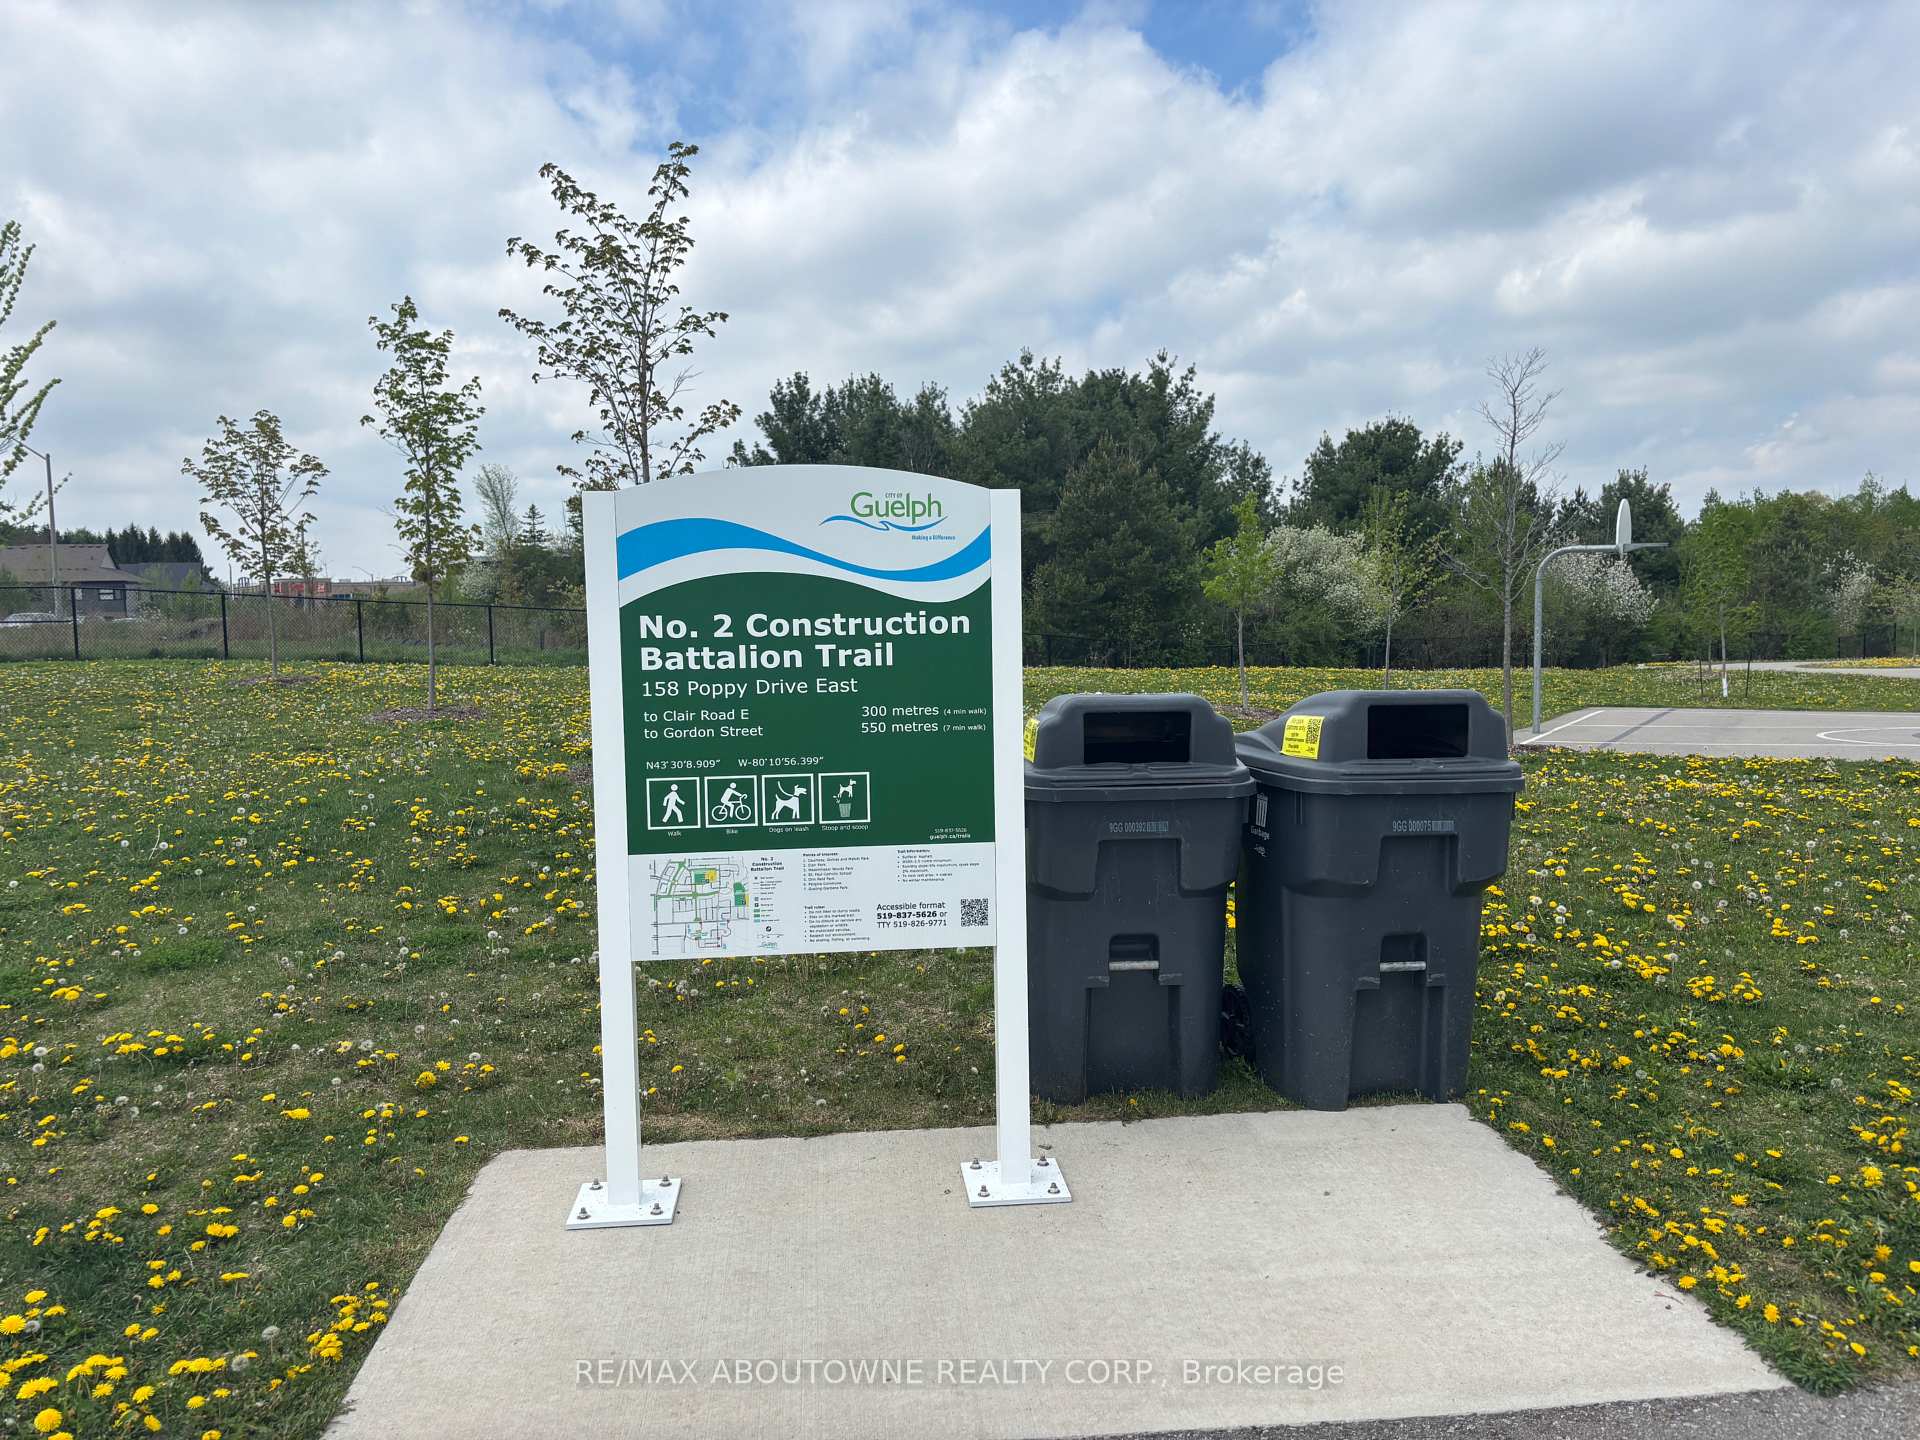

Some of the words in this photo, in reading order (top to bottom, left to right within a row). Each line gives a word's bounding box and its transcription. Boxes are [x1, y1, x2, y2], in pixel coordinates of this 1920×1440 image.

[850, 491, 942, 525] Guelph
[640, 615, 698, 639] No.
[714, 614, 734, 638] 2
[746, 610, 970, 638] Construction
[641, 645, 803, 671] Battalion
[816, 642, 894, 669] Trail
[642, 680, 679, 698] 158
[688, 680, 748, 698] Poppy
[756, 678, 808, 695] Drive
[816, 678, 858, 694] East
[644, 711, 659, 723] to
[663, 710, 696, 722] Clair
[700, 708, 736, 721] Road
[741, 709, 750, 720] E
[862, 705, 887, 718] 300
[892, 704, 940, 716] metres
[968, 707, 987, 716] walk)
[644, 728, 659, 739] to
[664, 726, 715, 738] Gordon
[720, 725, 764, 738] Street
[861, 722, 886, 734] 550
[892, 721, 939, 733] metres
[968, 723, 986, 732] walk)
[1392, 820, 1407, 832] 9GG
[877, 902, 917, 910] Accessible
[877, 911, 937, 919] 519-837-5626
[893, 920, 946, 928] 519-826-9771
